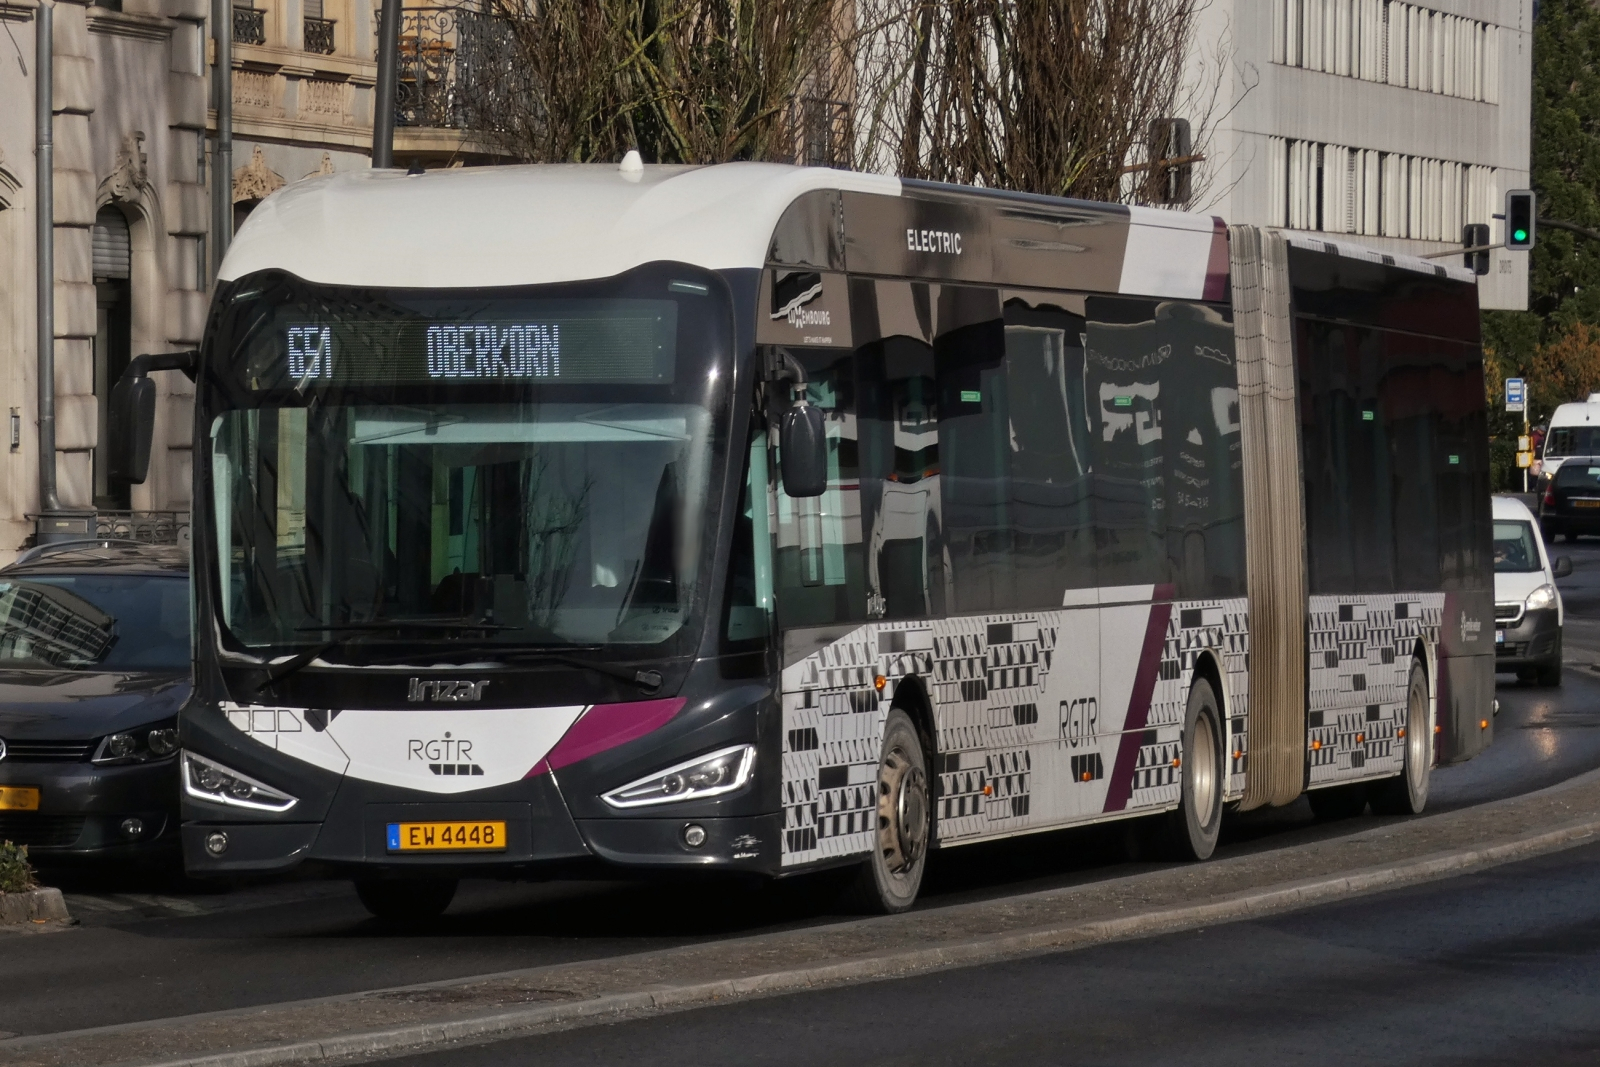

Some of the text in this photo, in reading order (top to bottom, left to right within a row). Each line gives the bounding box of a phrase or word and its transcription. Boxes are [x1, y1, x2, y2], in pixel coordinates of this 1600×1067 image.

[906, 228, 962, 255] ELECTRIC
[288, 324, 560, 378] 651 OBERKORN
[407, 677, 490, 701] Irizar
[1059, 697, 1098, 750] RGTR
[408, 737, 473, 761] RGTR
[409, 826, 435, 846] EW
[441, 825, 495, 845] 4448
